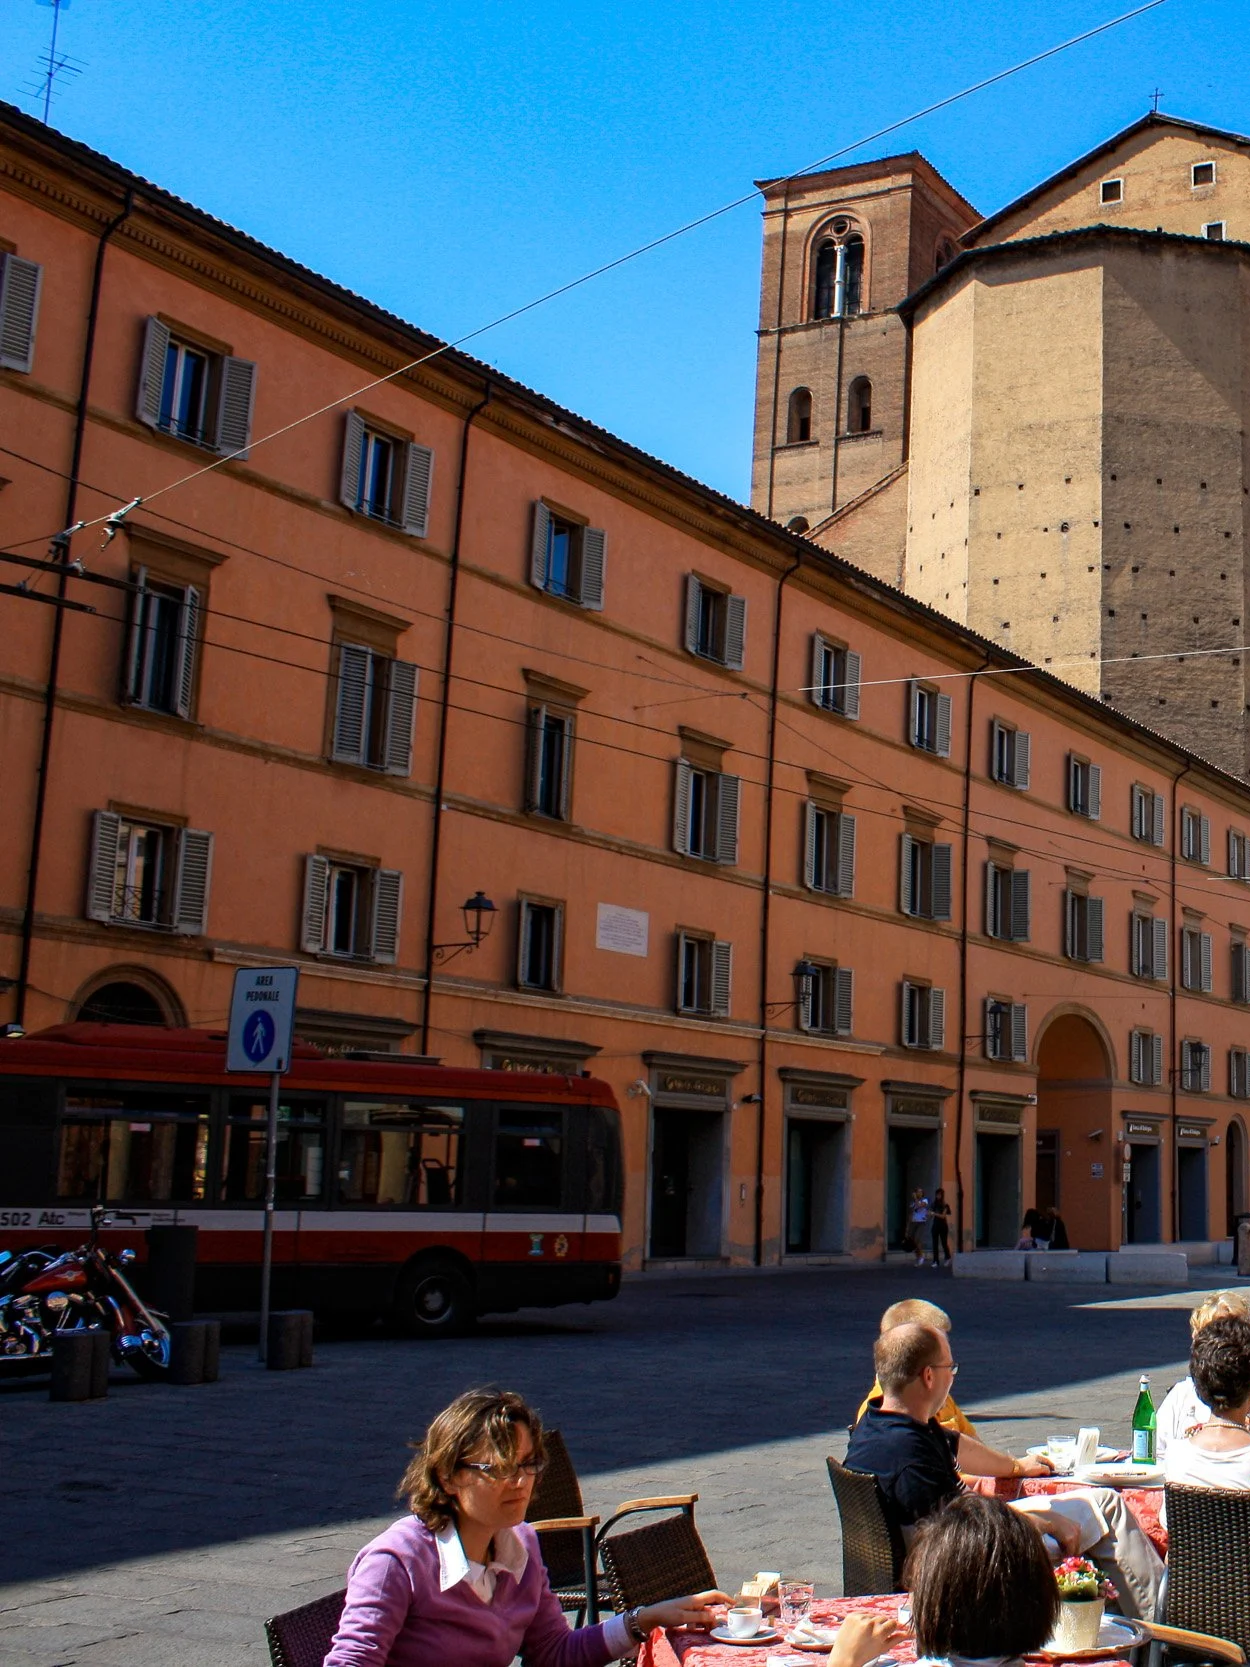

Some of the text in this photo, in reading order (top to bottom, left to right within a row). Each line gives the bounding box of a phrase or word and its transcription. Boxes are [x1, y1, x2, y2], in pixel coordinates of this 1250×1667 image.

[255, 975, 274, 986] AREA
[246, 990, 280, 1002] PEDONALE
[0, 1211, 66, 1226] 502 Atc
